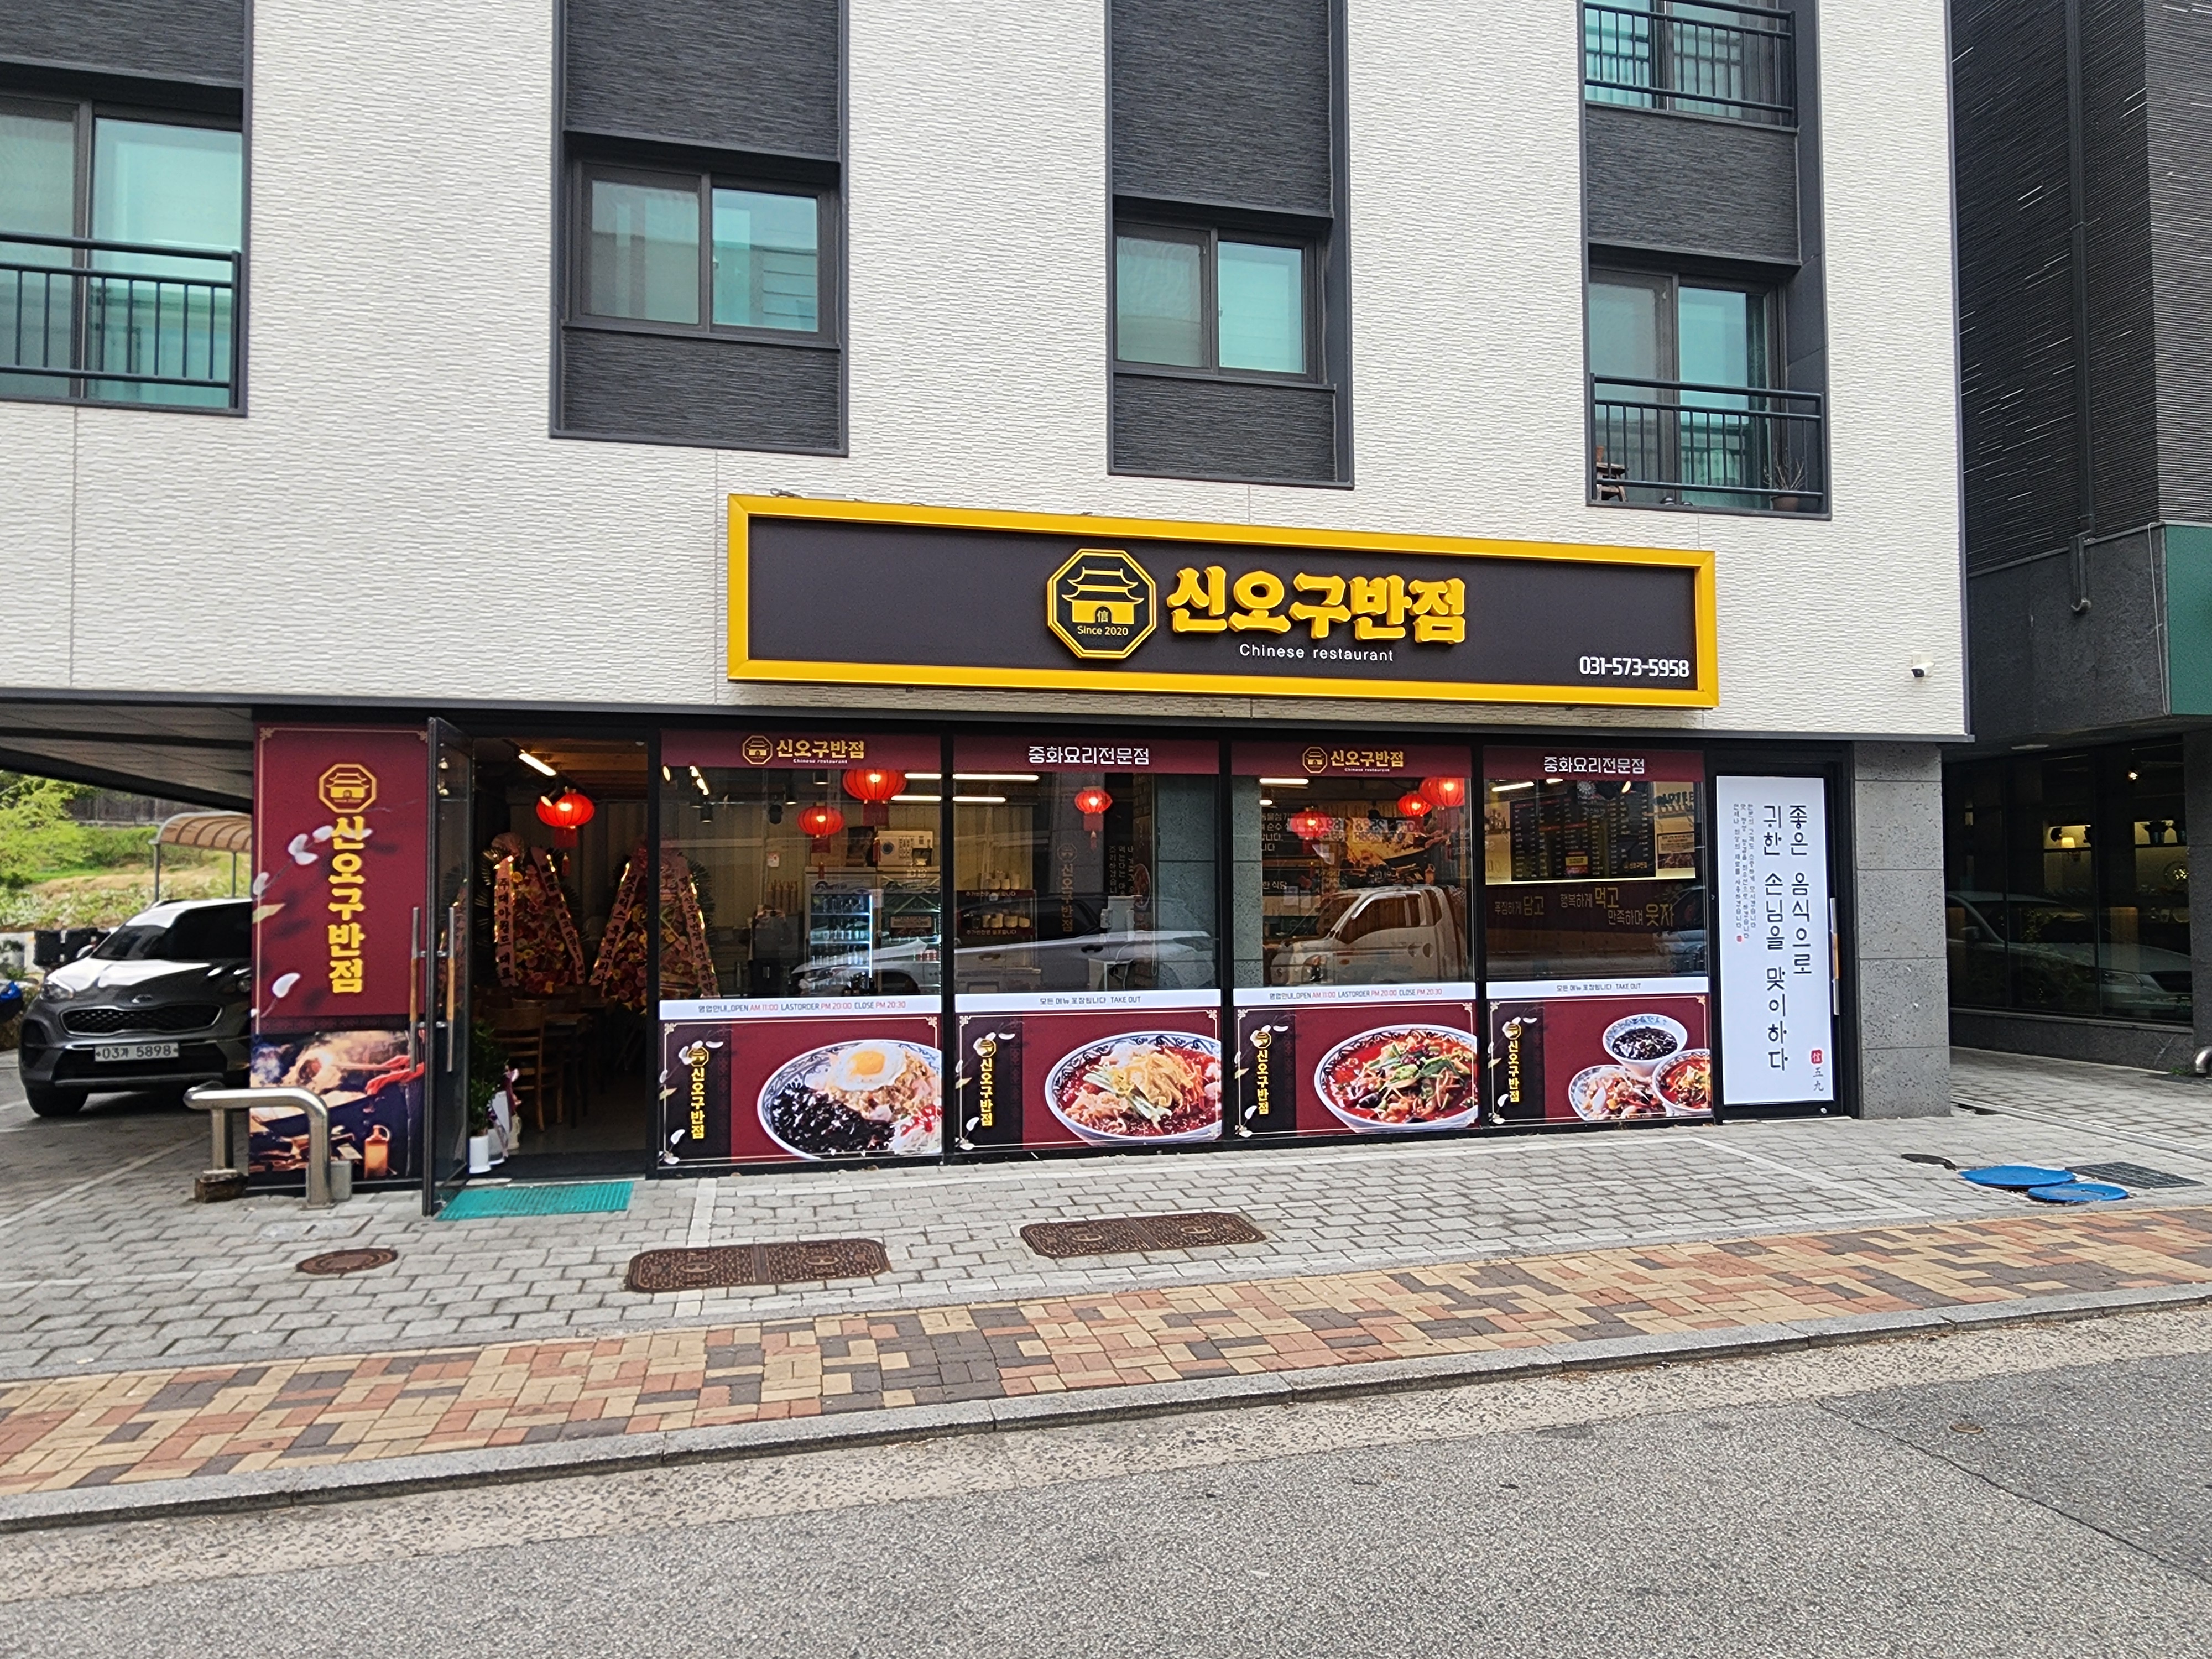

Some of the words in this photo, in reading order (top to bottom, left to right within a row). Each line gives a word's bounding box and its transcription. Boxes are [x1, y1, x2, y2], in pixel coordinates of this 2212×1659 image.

[1167, 565, 1465, 645] 신오구반점
[1077, 625, 1102, 636] Since
[1104, 625, 1129, 637] 2020
[1239, 643, 1305, 659] Chinese
[1313, 646, 1394, 661] restaurant
[1579, 655, 1689, 679] 031-573-5958
[776, 739, 865, 759] 신오구반점
[1028, 745, 1150, 765] 중화요리전문점
[1330, 750, 1404, 768] 신오구반점
[1543, 755, 1645, 774] 중화요리전문점
[1763, 805, 1782, 857] 귀한
[1789, 804, 1808, 856] 좋은
[1109, 845, 1117, 894] 조리하겠습니
[328, 815, 366, 994] 신오구반점
[1061, 864, 1073, 932] 신오구반점
[1523, 895, 1545, 916] 담고
[1559, 893, 1593, 908] 행복하게
[1595, 887, 1619, 909] 먹고
[1608, 909, 1644, 925] 만족하며
[1646, 903, 1674, 927] 웃자
[1764, 872, 1785, 950] 손님을
[1791, 872, 1812, 975] 음식으로
[781, 1003, 820, 1011] LASTORDER
[821, 1003, 831, 1011] PM
[832, 1002, 852, 1010] 20:00
[854, 1001, 874, 1010] CLOSE
[886, 1001, 906, 1009] 20:30
[1766, 966, 1789, 1071] 맞이하다
[136, 1045, 171, 1057] 5898
[1507, 1040, 1520, 1103] 신오구반점
[691, 1067, 705, 1139] 신오구반점
[979, 1058, 993, 1127] 신오구반점
[1256, 1050, 1269, 1115] 신오구반점
